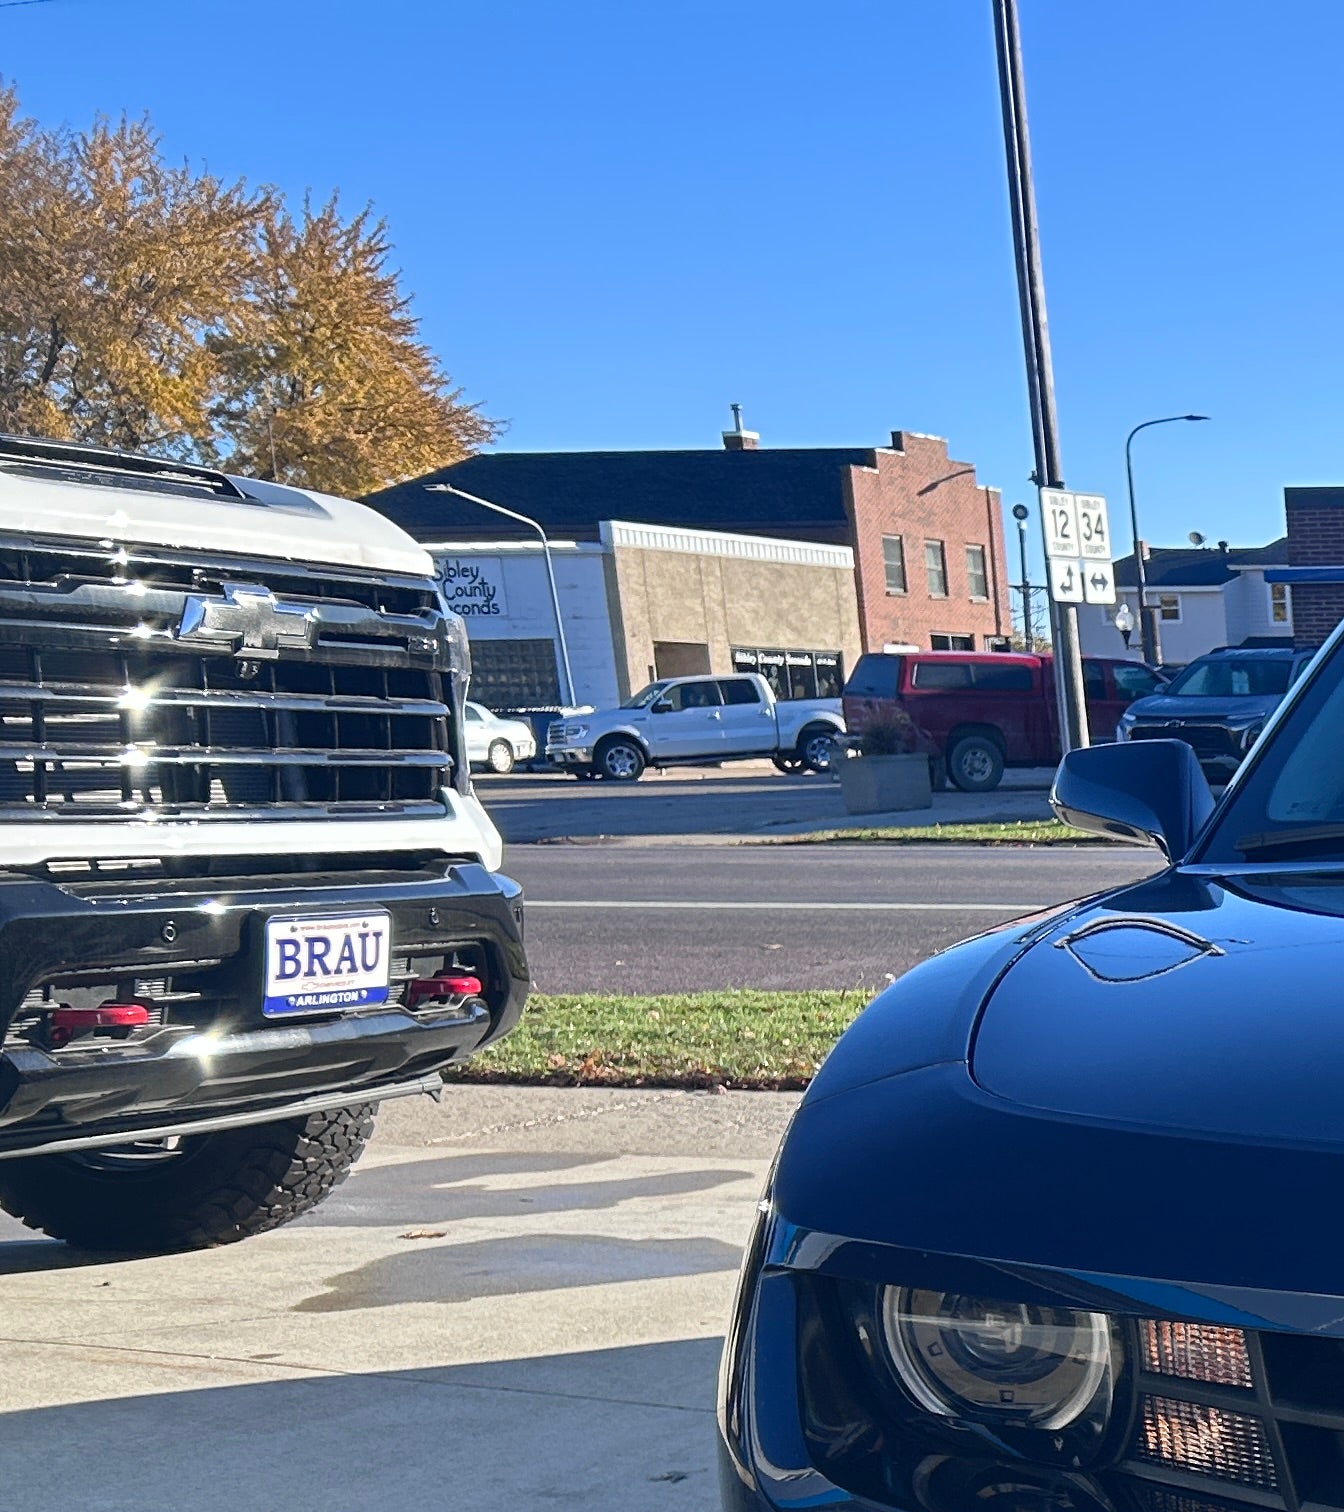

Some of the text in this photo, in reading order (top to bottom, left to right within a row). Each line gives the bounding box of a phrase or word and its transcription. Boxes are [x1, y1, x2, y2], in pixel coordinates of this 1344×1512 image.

[1051, 508, 1071, 539] 12
[1082, 512, 1105, 543] 34
[442, 577, 496, 603] County
[449, 600, 500, 615] conds
[275, 931, 383, 980] BRAU
[296, 991, 359, 1007] ARLINGTON
